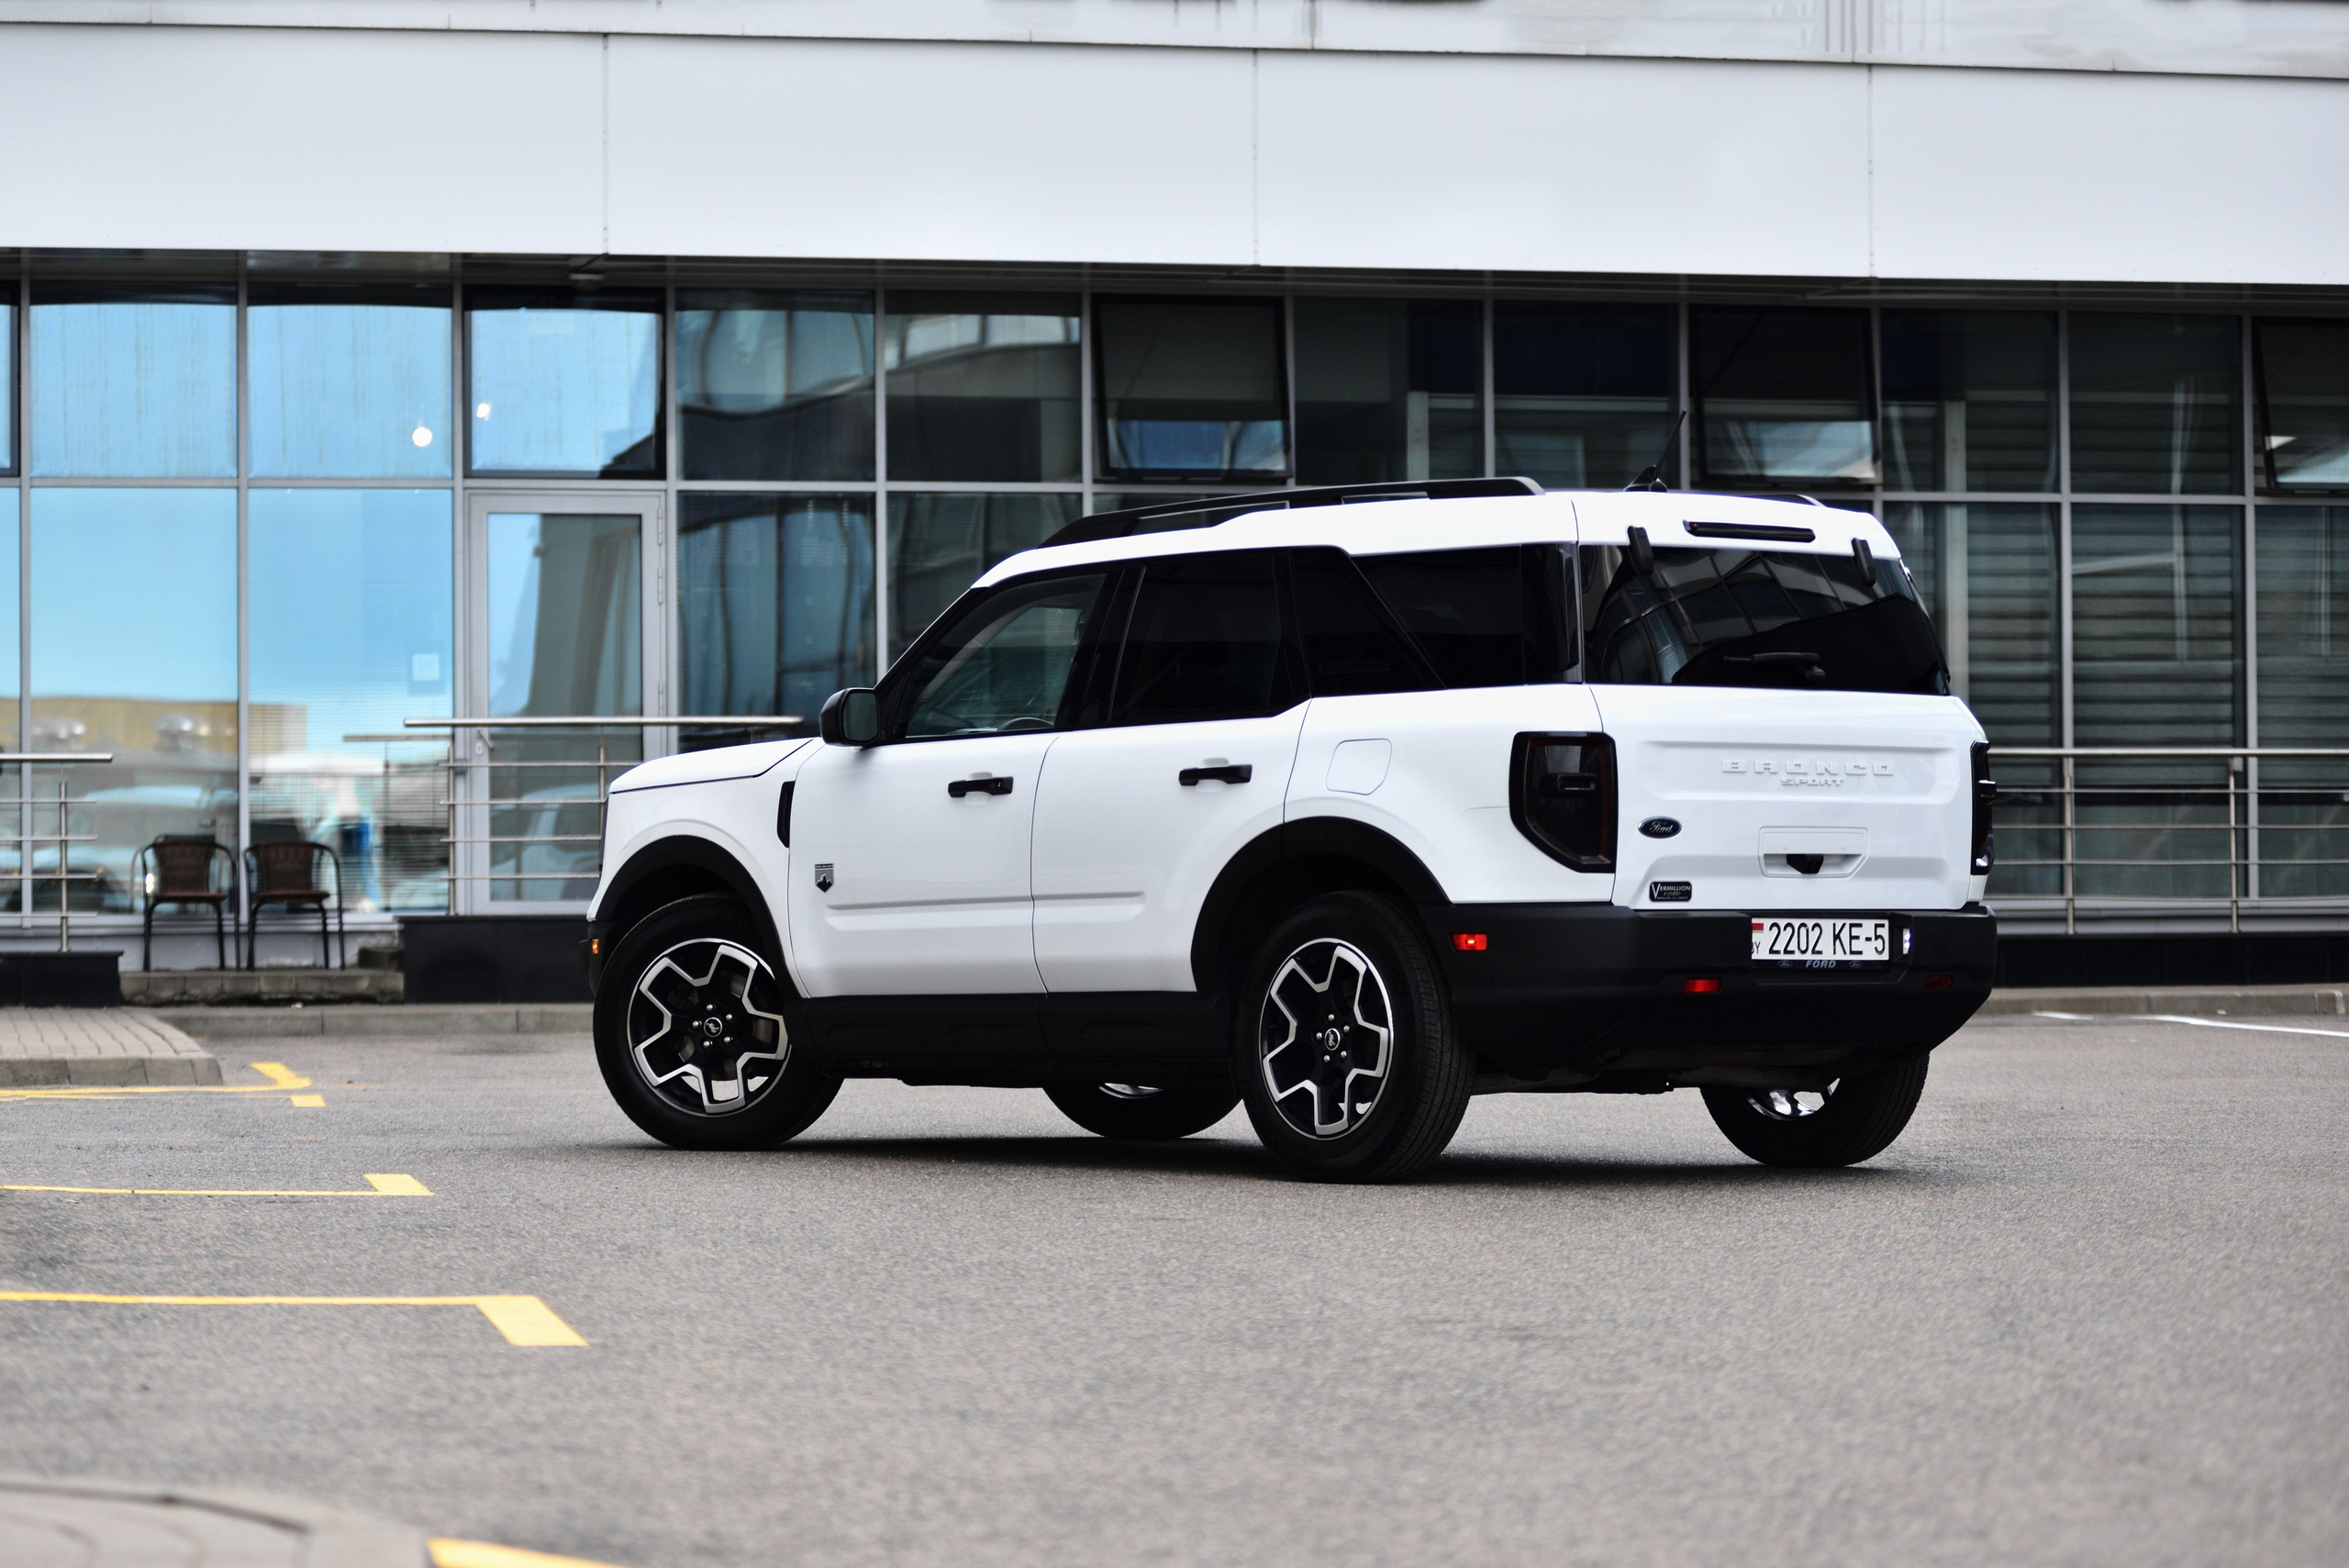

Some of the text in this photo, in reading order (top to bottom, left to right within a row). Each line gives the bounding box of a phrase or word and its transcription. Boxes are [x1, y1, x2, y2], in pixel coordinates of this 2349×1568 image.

[1720, 759, 1895, 777] BRONCO
[1780, 778, 1844, 786] SPORT
[1649, 821, 1674, 833] Ford
[1651, 883, 1691, 899] VERMILLION
[1768, 921, 1886, 955] 2202 KE-5
[1805, 960, 1837, 969] FORD
